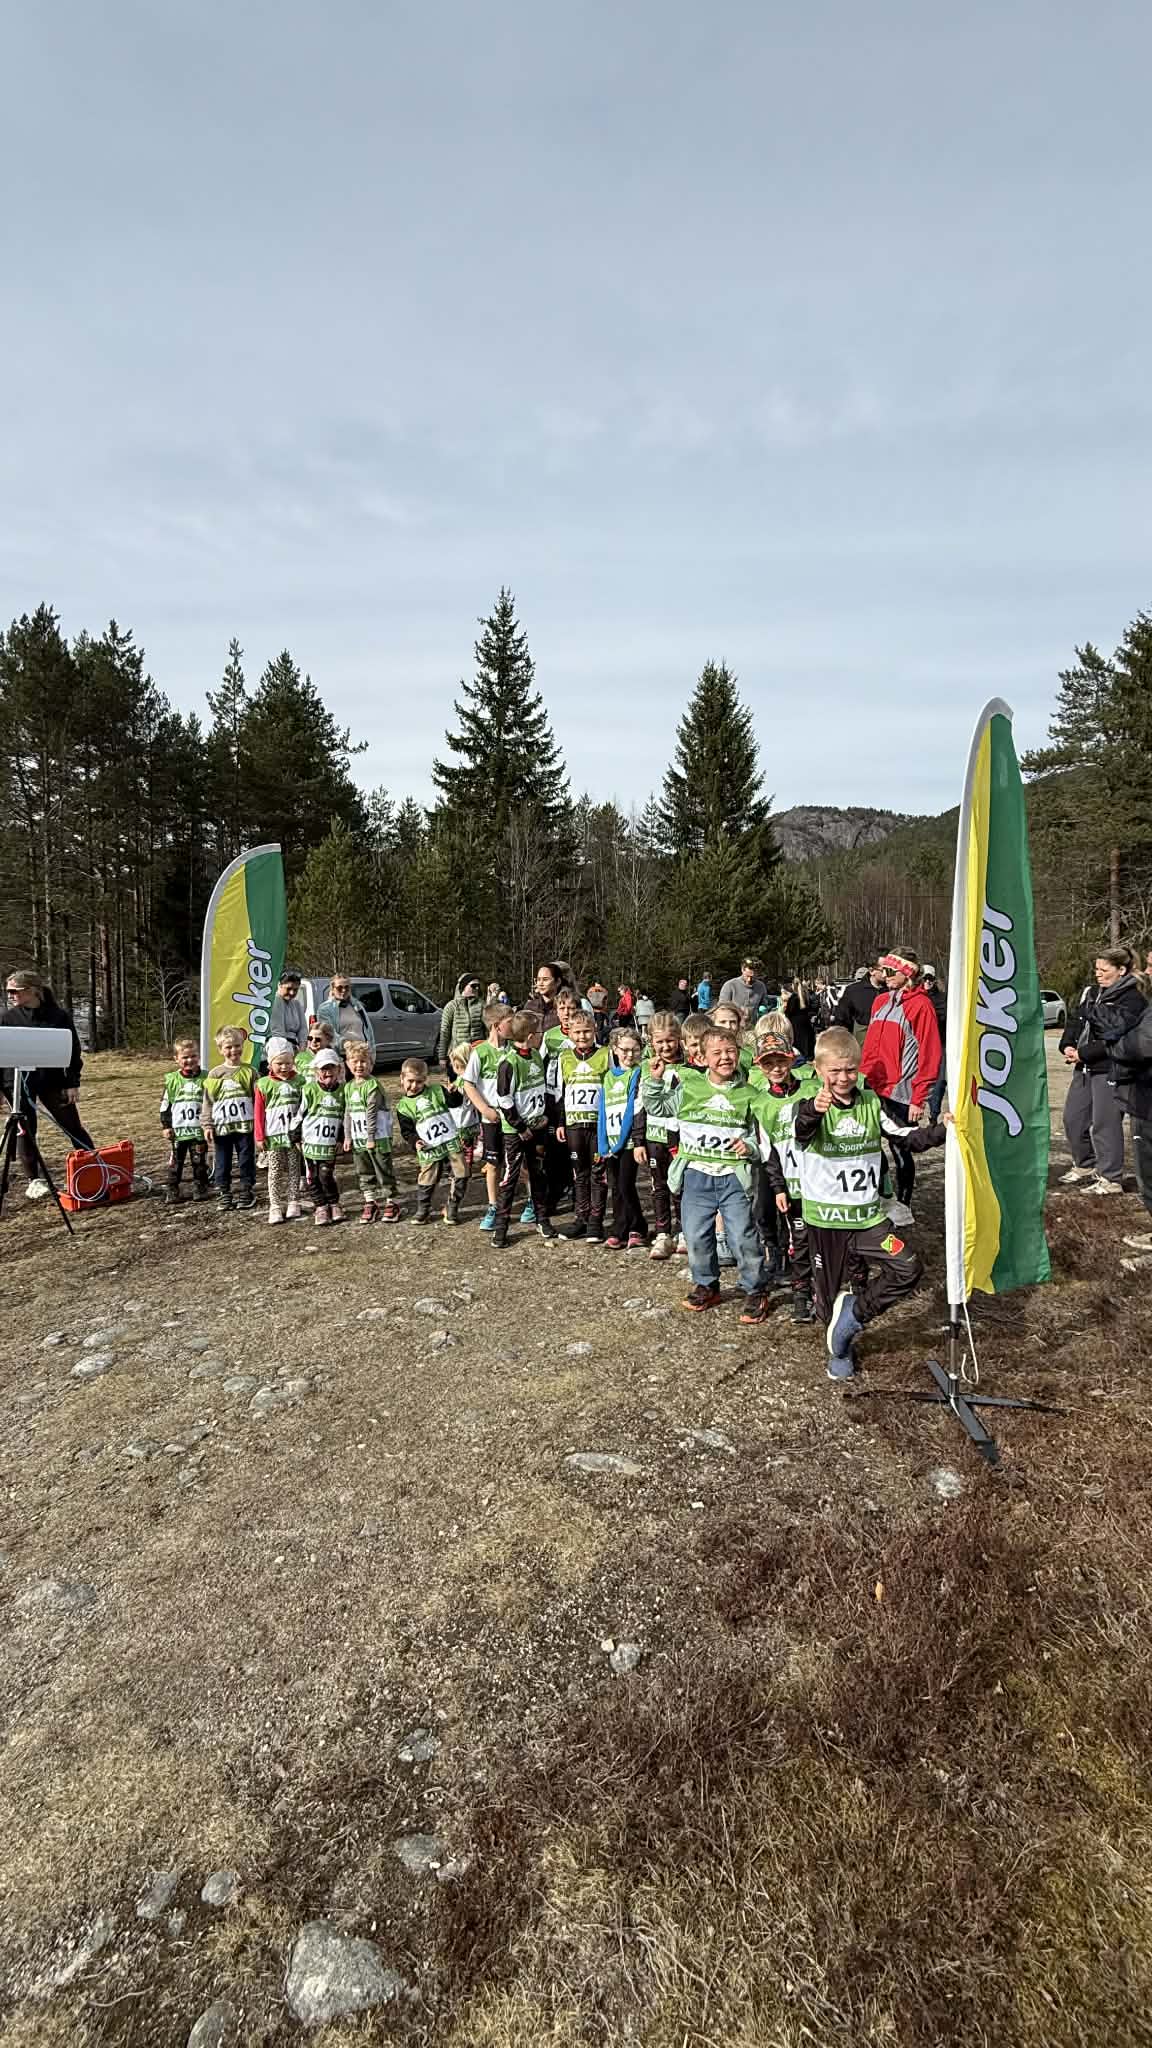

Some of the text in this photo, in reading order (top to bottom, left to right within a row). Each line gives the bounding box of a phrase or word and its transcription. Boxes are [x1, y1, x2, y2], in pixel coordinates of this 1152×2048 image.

[530, 1094, 544, 1109] 13
[571, 1089, 597, 1105] 127
[220, 1102, 246, 1118] 101
[608, 1112, 622, 1127] 11
[314, 1124, 336, 1138] 102
[426, 1121, 450, 1140] 123
[648, 1127, 666, 1138] VAL
[836, 1166, 877, 1193] 121
